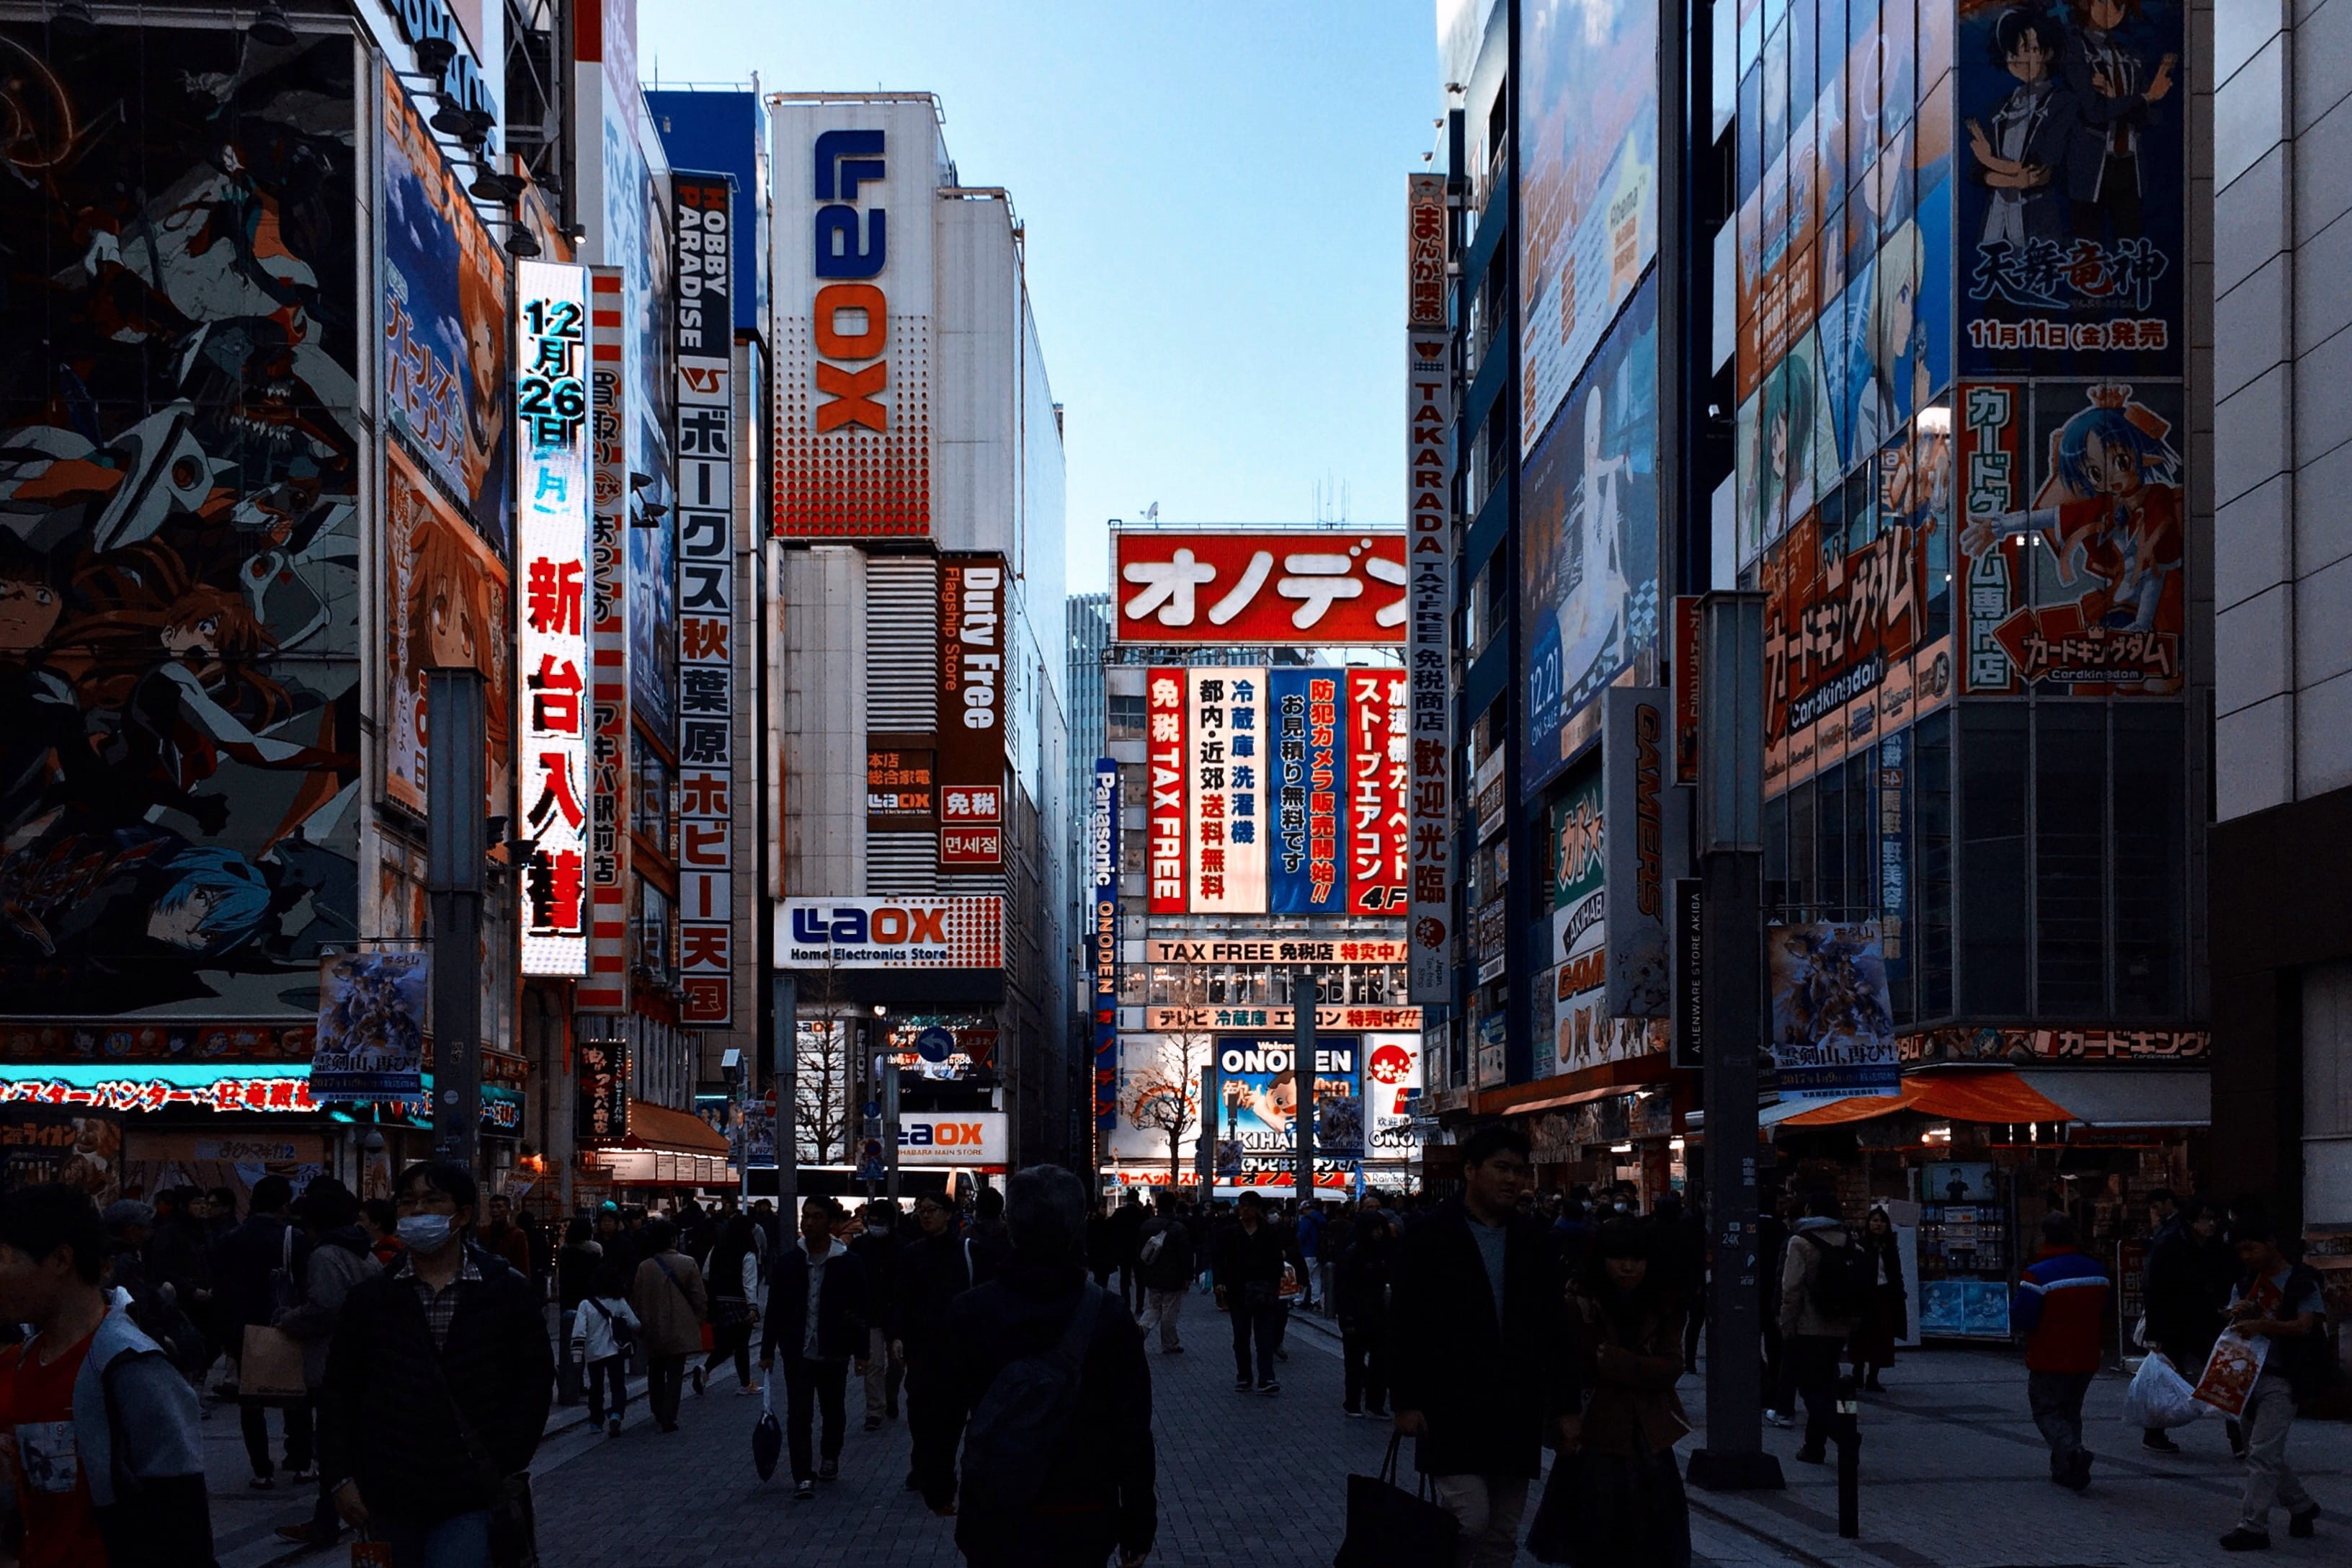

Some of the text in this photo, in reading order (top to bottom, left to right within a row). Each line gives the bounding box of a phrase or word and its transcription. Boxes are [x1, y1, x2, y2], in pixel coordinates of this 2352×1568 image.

[677, 185, 703, 349] PARADISE
[703, 186, 728, 298] HOBBY
[1412, 205, 1441, 320] まんが喫茶
[1414, 383, 1444, 553] TAKARADA
[1969, 387, 2009, 687] カードゲム専門店
[941, 566, 960, 692] Flagship Store
[960, 567, 1000, 729] Duty Free
[1529, 645, 1560, 719] 12.21
[1764, 519, 1923, 736] カードキングダム
[2022, 632, 2171, 677] カードキングダム
[1414, 648, 1445, 731] 免税商店
[868, 752, 900, 767] 本店
[868, 769, 931, 785] 総合家電
[946, 792, 997, 815] 免税
[1152, 679, 1180, 899] 免税 TAX FREE
[1200, 680, 1224, 901] 都内・近郊送料無料
[1280, 695, 1306, 874] お見積り無料です
[1355, 679, 1381, 881] ストーブエアコン
[1635, 702, 1662, 925] GAMERS
[945, 836, 998, 855] 면세점
[1096, 772, 1115, 886] Panasonic
[1414, 739, 1446, 904] 歓迎光臨
[792, 948, 947, 960] Home Electronics Store
[1098, 901, 1114, 994] ONODEN
[1159, 943, 1407, 961] TAX FREE 免税店 特卖中!
[1569, 894, 1605, 943] AKIHAB
[1691, 893, 1701, 1054] ALIENWARE STORE AKIBA
[966, 1037, 992, 1046] 止まれ
[1160, 1010, 1209, 1026] テレビ
[1215, 1010, 1267, 1026] 冷蔵庫
[1275, 1011, 1341, 1026] エコン
[1221, 1050, 1351, 1073] ONOEN
[2059, 1030, 2211, 1057] カードキング
